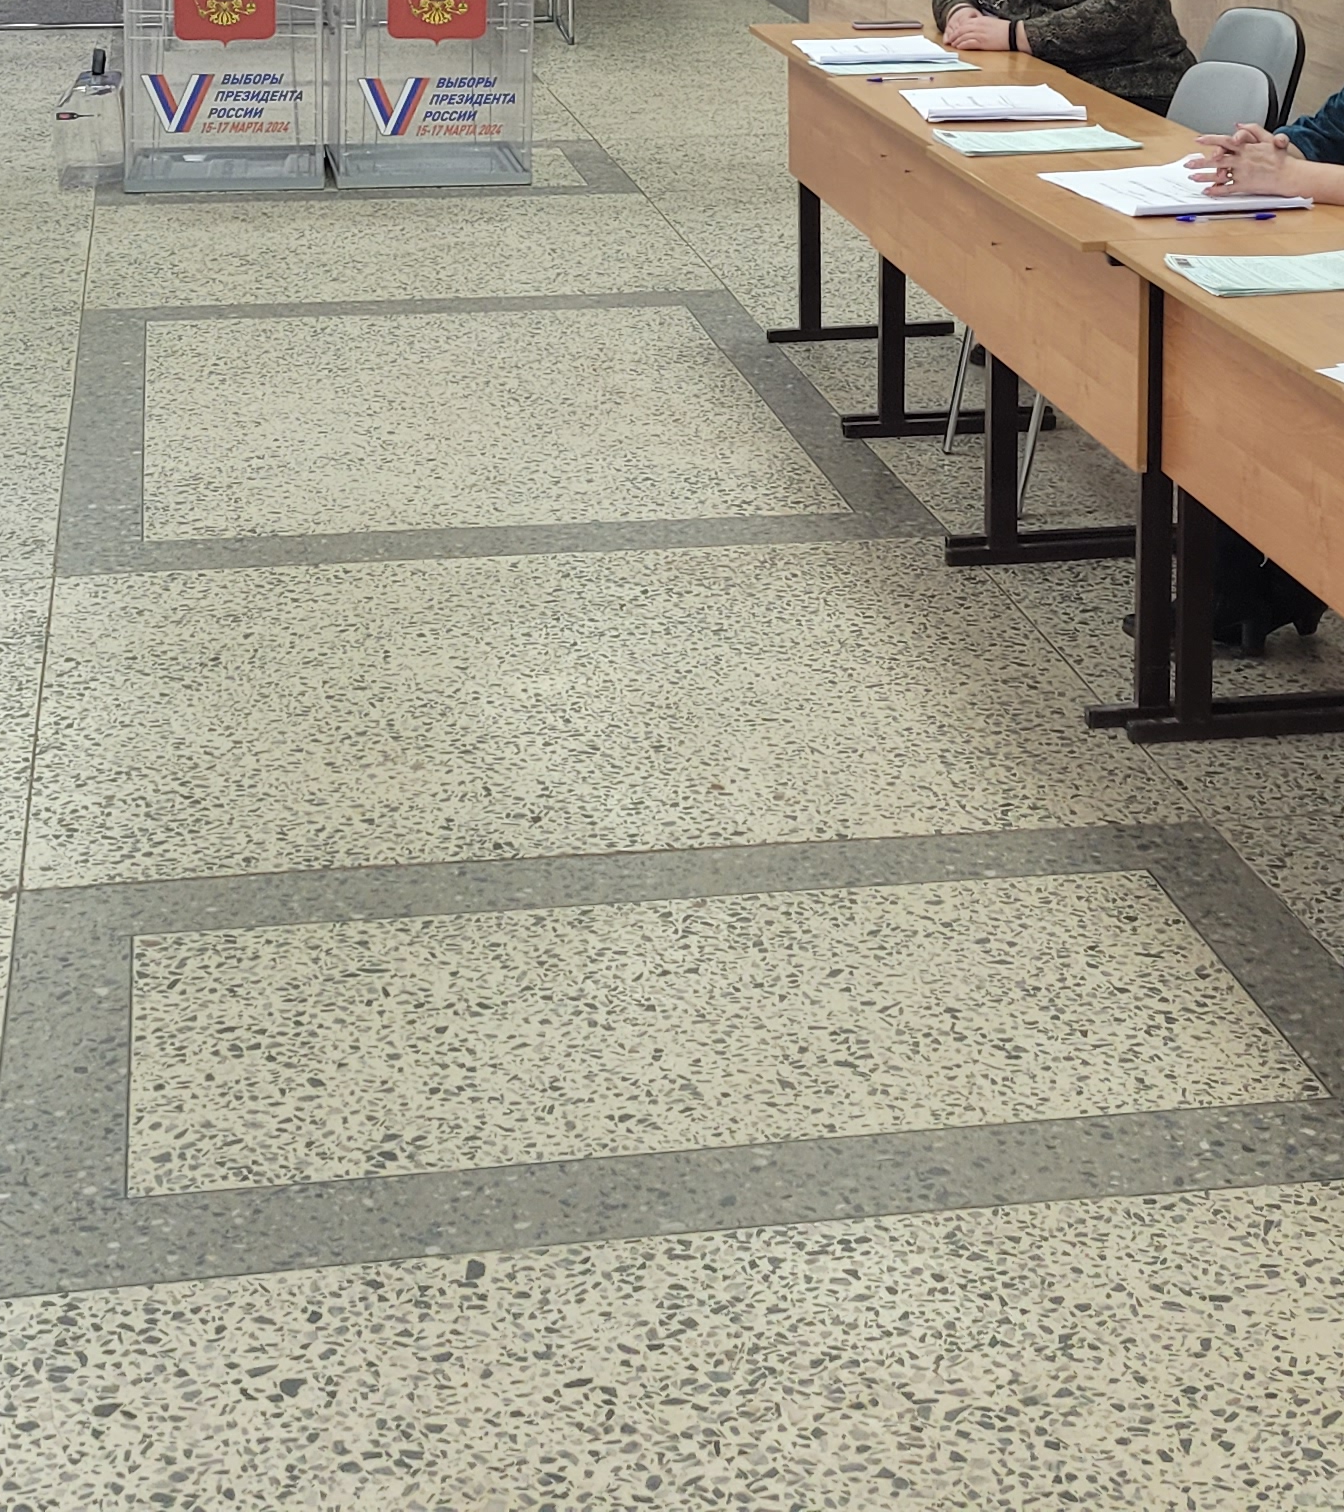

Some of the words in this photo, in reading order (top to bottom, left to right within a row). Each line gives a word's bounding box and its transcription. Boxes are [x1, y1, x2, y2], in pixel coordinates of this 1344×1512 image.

[221, 73, 284, 85] ВЫБОРЫ
[436, 76, 497, 89] ВЫБОРЫ
[214, 90, 303, 103] ПРЕЗИДЕНТА
[429, 93, 516, 106] ПРЕЗИДЕНТА
[208, 107, 265, 119] РОССИИ
[423, 110, 478, 122] РОССИИ
[201, 121, 229, 133] 15-17
[229, 121, 263, 133] МАРТА
[265, 121, 290, 133] 2024
[416, 124, 443, 136] 15-17
[443, 124, 476, 136] МАРТА
[478, 124, 504, 136] 2024
